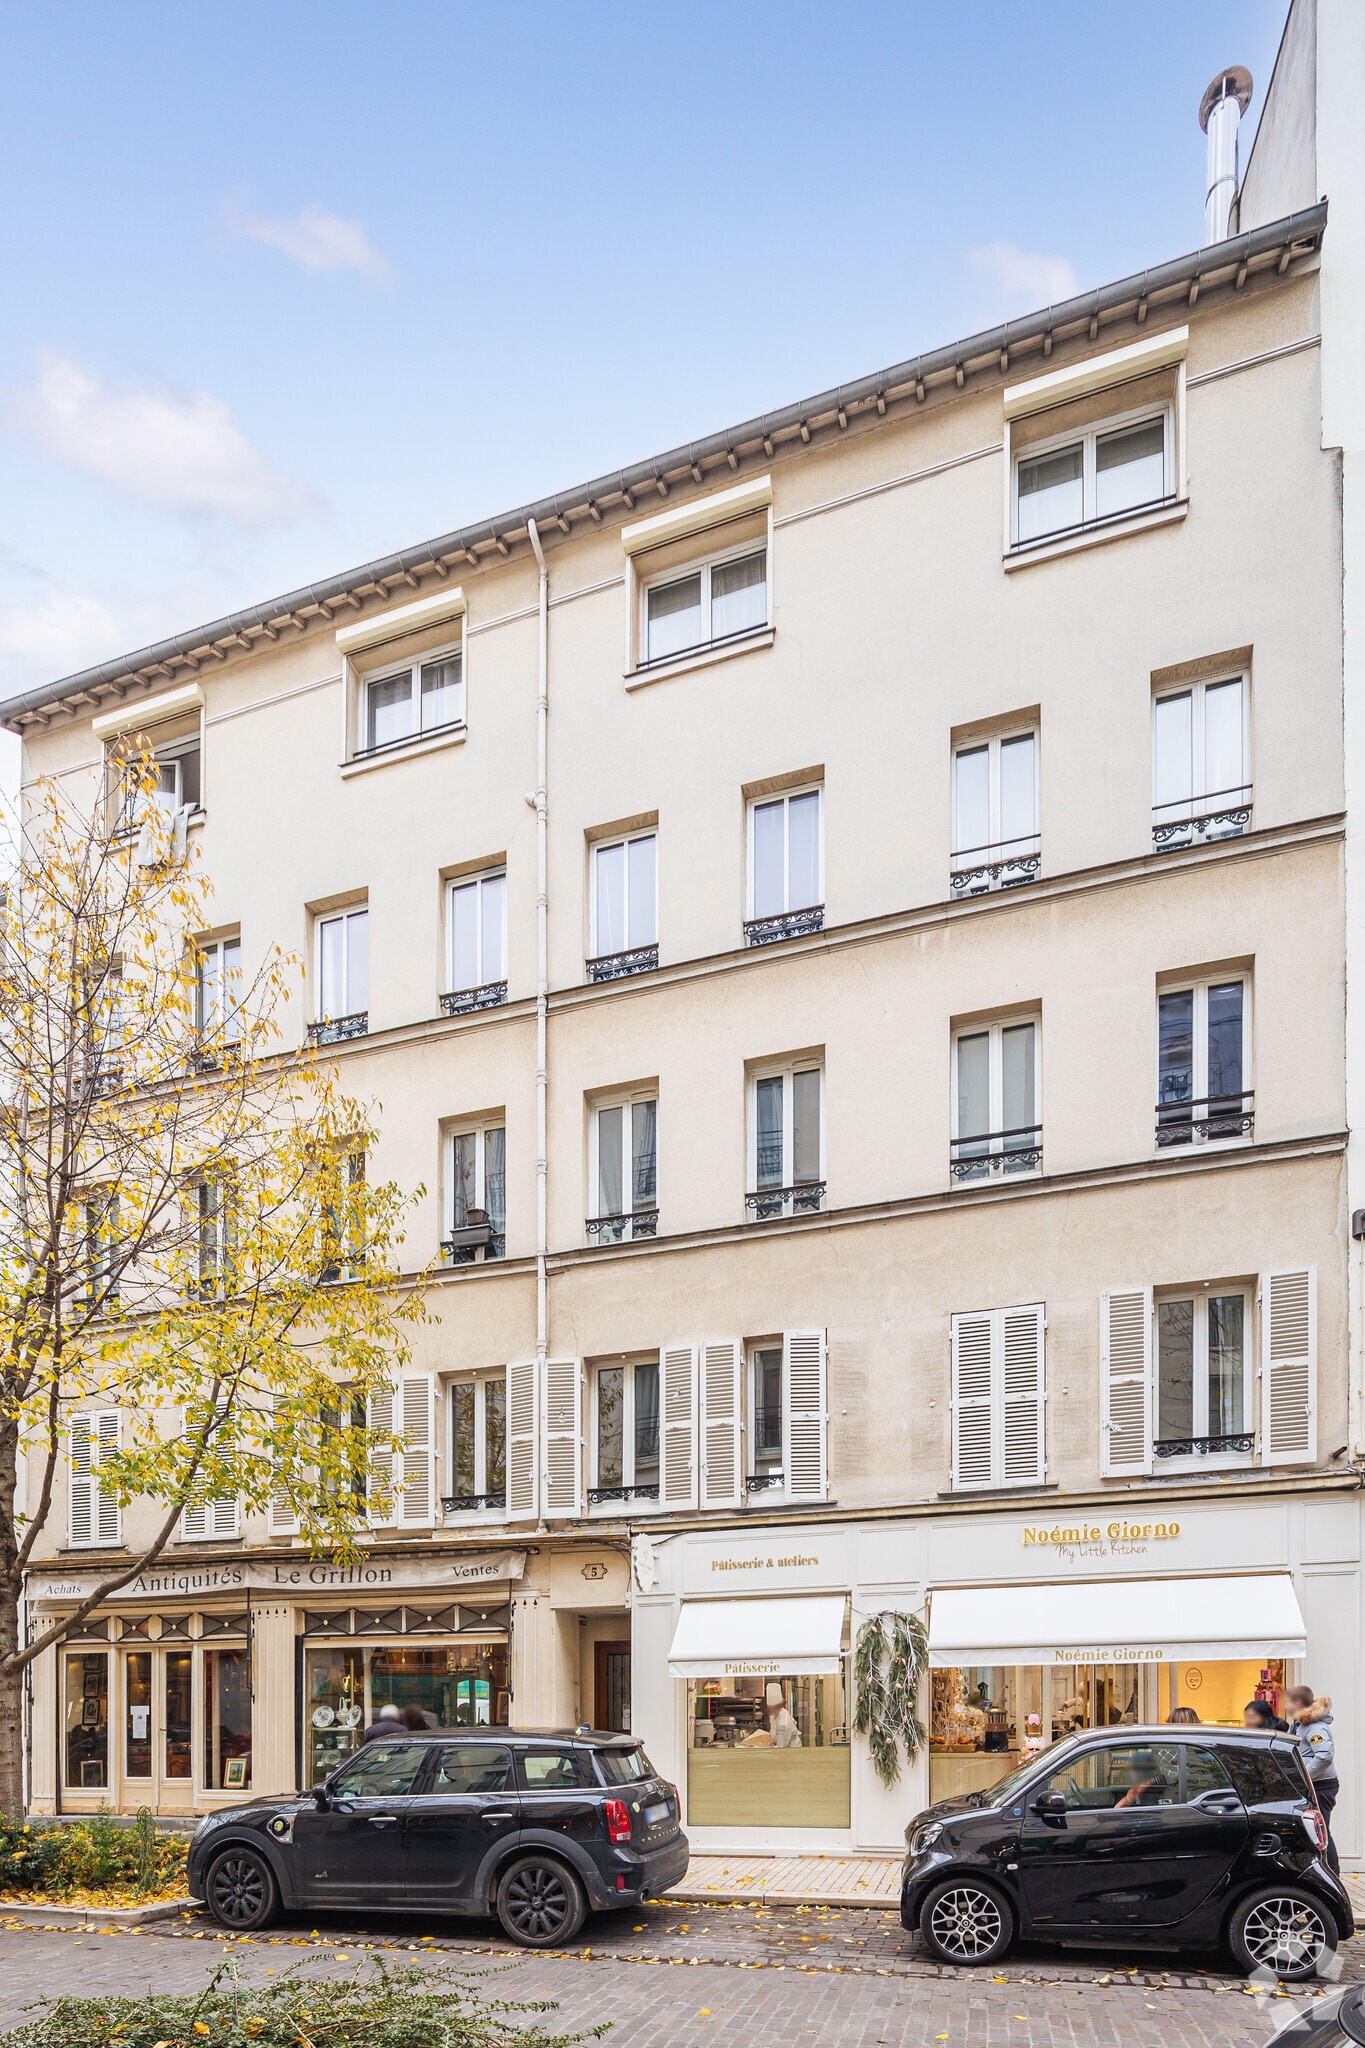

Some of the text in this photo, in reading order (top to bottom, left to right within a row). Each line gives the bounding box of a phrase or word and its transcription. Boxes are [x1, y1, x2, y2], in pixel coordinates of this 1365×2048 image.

[1022, 1521, 1181, 1545] Noémie Giorno
[1055, 1539, 1149, 1564] My Little Kitchen
[711, 1555, 819, 1571] Pâtisserie & ateliers
[273, 1564, 393, 1584] Le Grillon
[452, 1564, 499, 1578] Ventes
[591, 1567, 598, 1577] 5
[132, 1566, 242, 1593] Antiquités
[44, 1584, 82, 1595] Achats
[1055, 1647, 1163, 1661] Noémie Giorno
[724, 1661, 780, 1674] Pâtisserie
